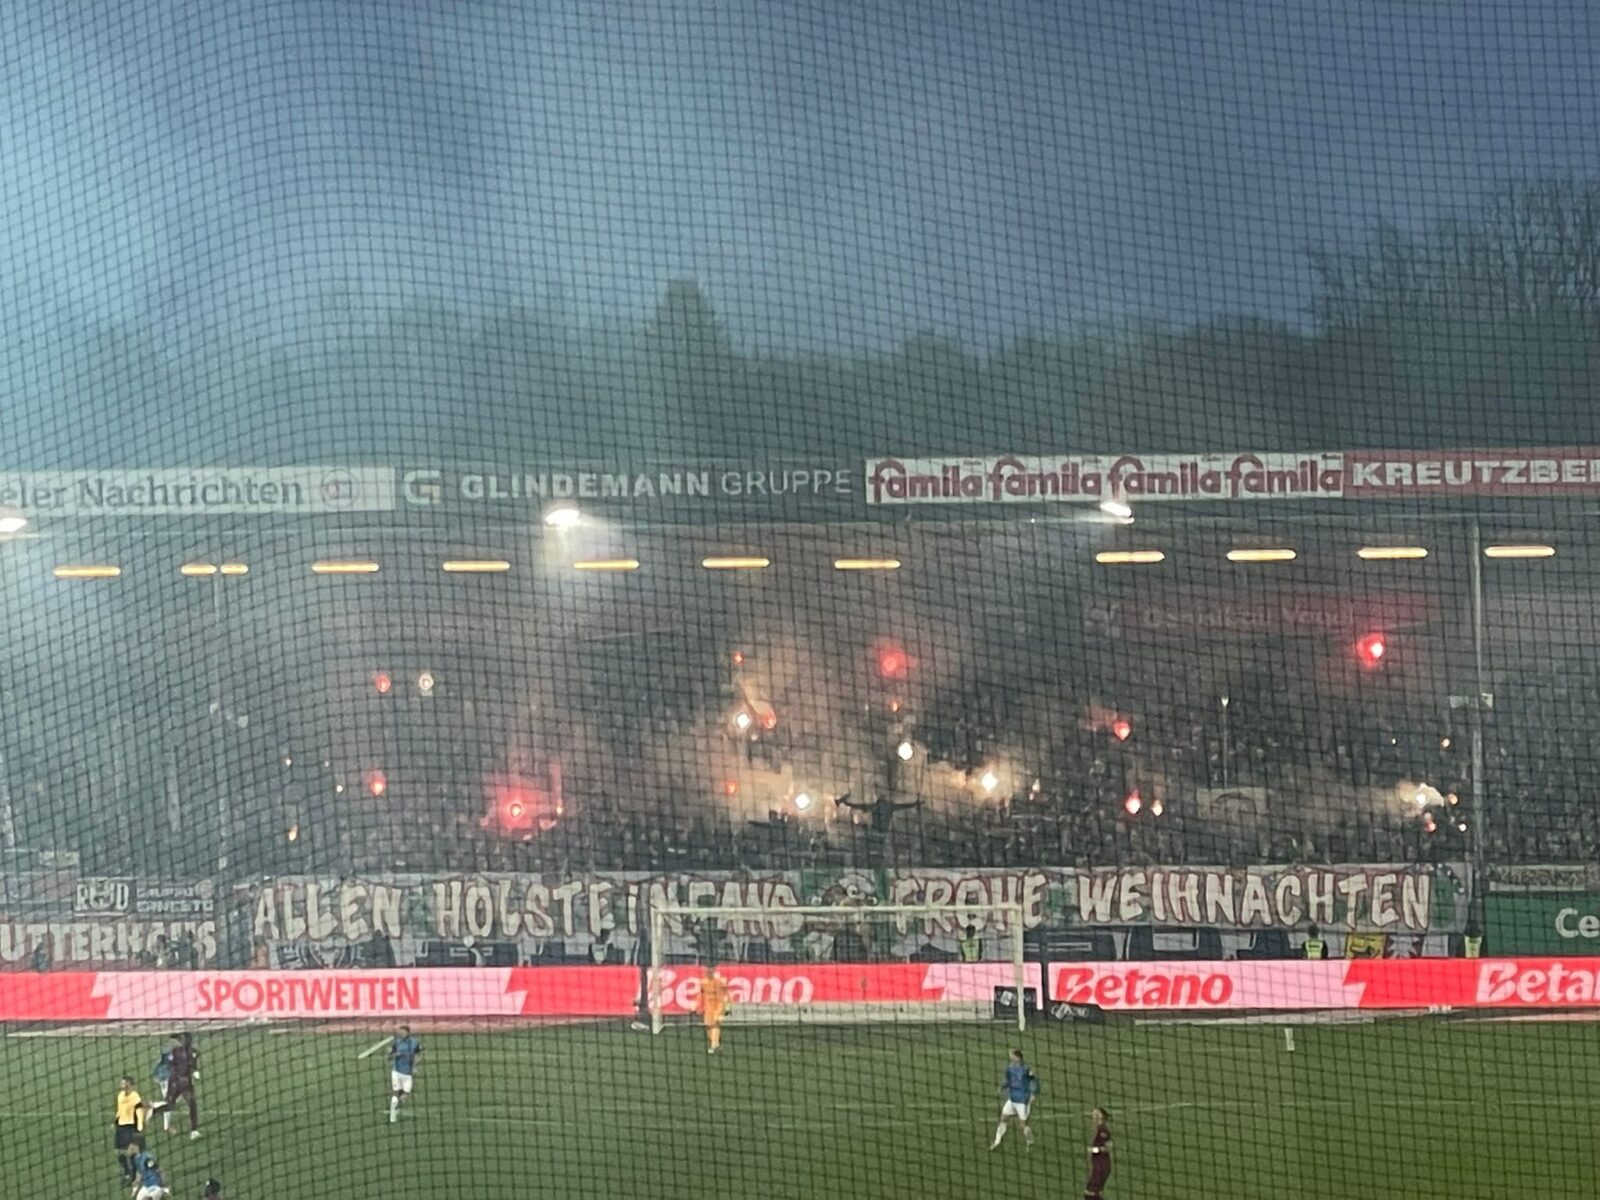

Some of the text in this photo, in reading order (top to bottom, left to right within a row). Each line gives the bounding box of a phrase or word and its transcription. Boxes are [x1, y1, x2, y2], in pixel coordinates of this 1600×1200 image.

[78, 475, 303, 507] Nachrichten
[460, 469, 852, 499] GLINDEMANN GRUPPE
[869, 458, 983, 503] famila
[988, 455, 1102, 500] famila
[1107, 455, 1221, 498] famila
[1226, 453, 1343, 497] famila
[253, 879, 403, 940] ALLEN
[893, 874, 1048, 935] FROHE
[1078, 871, 1431, 929] WEIHNACHTEN
[197, 977, 420, 1012] SPORTWETTEN
[1057, 966, 1233, 1006] Betano
